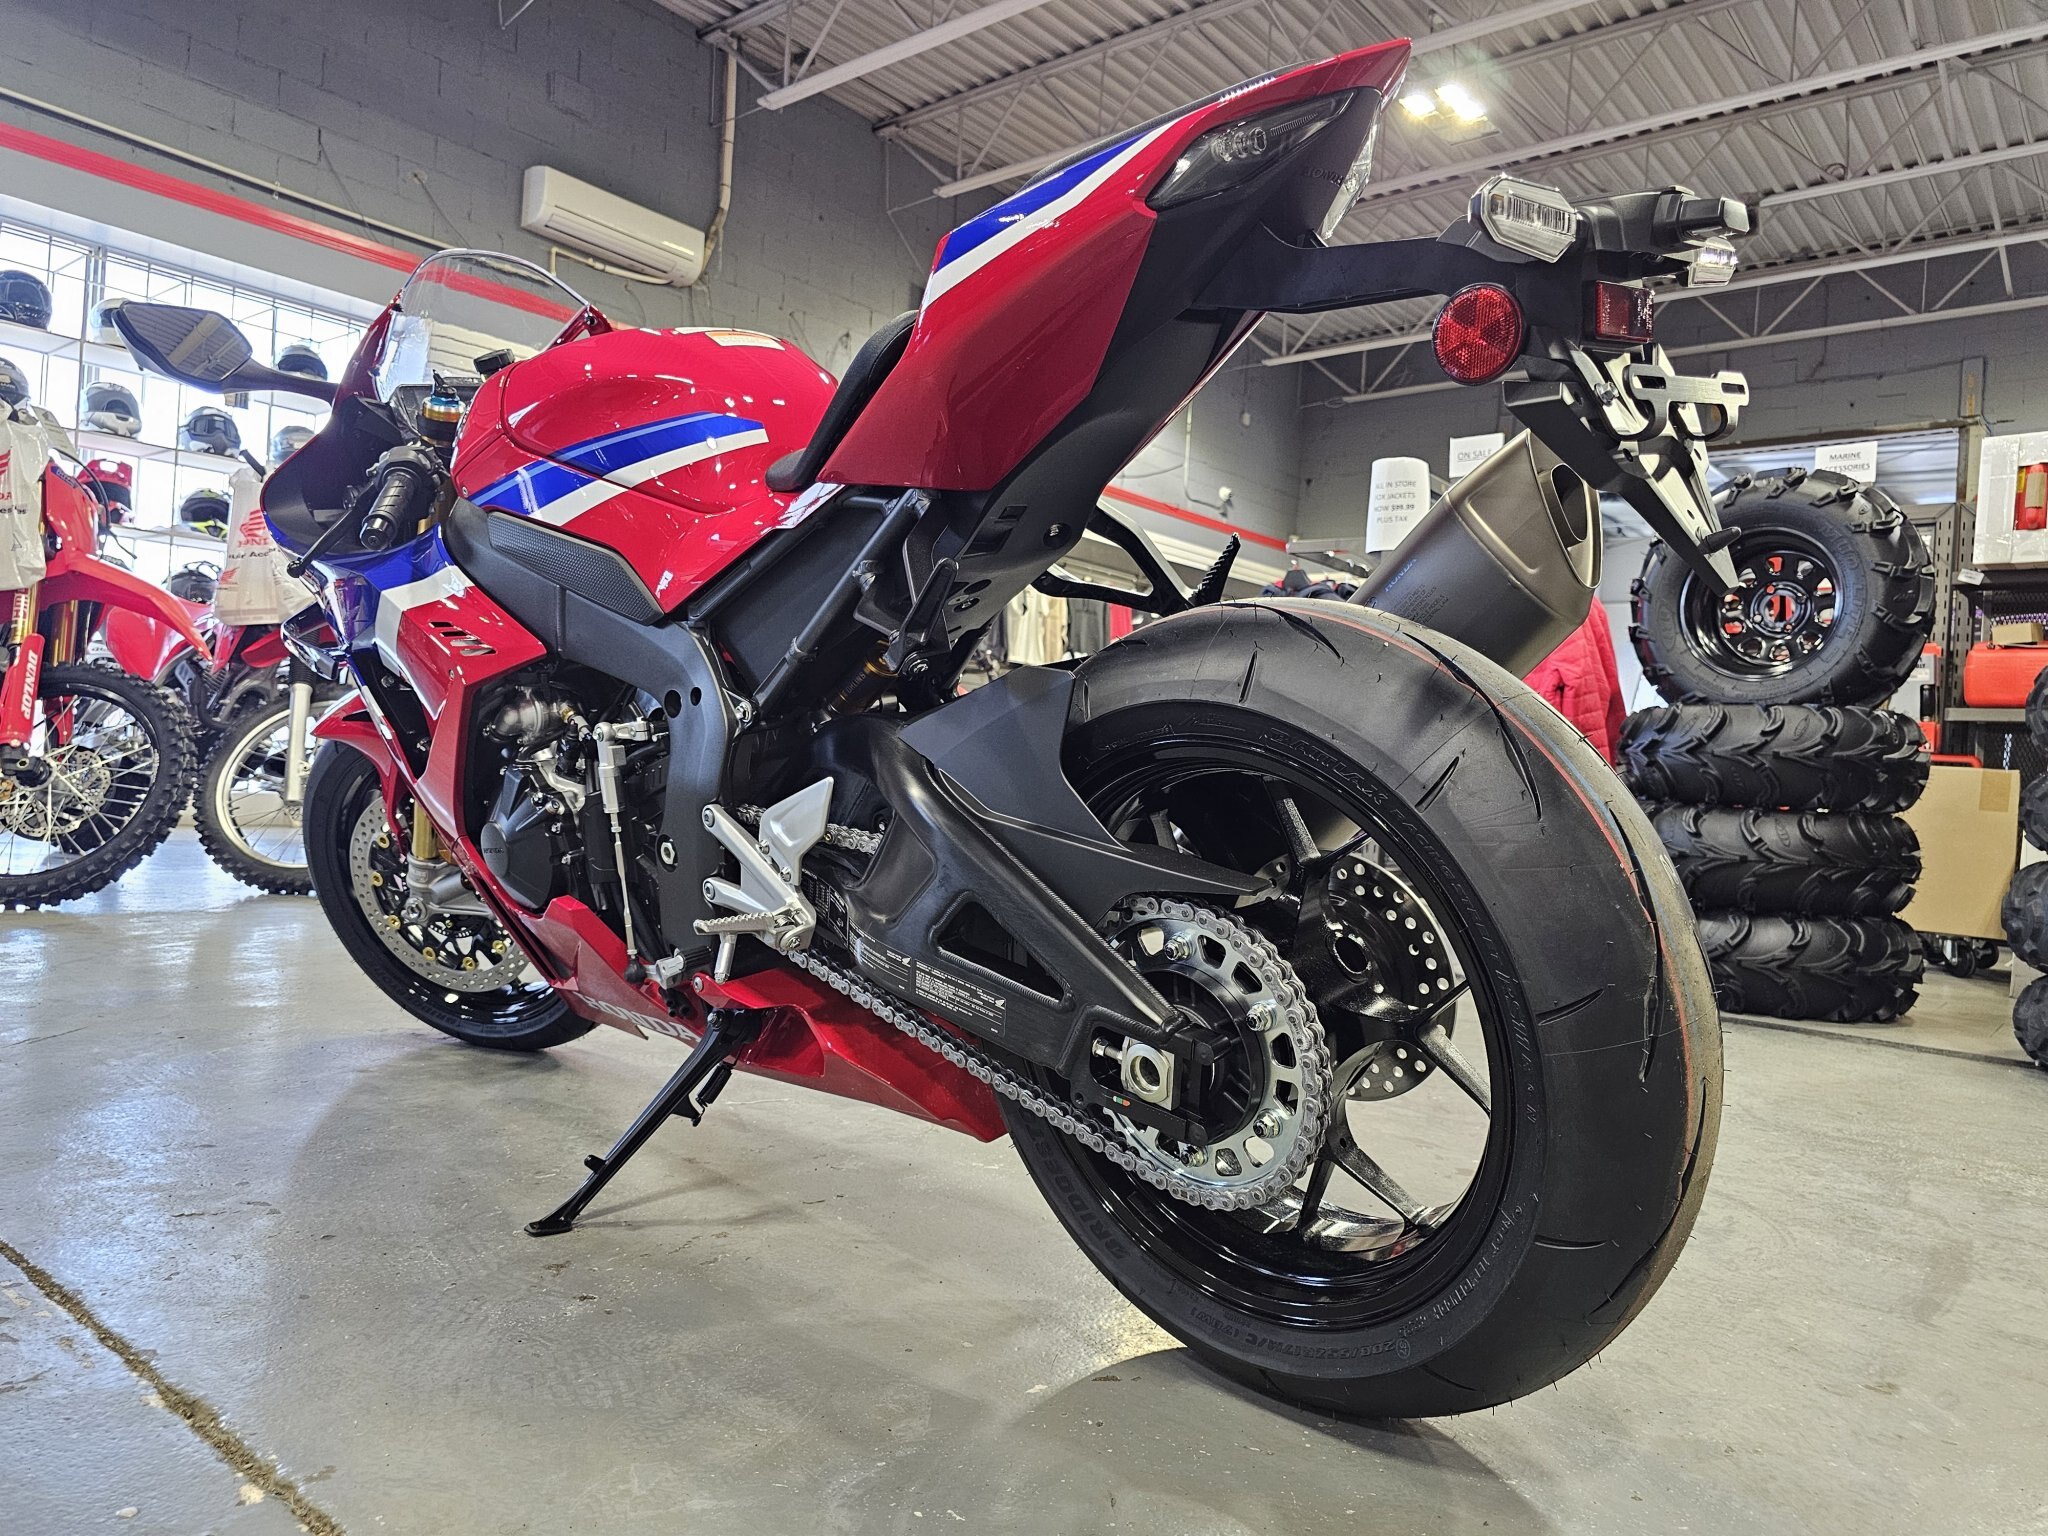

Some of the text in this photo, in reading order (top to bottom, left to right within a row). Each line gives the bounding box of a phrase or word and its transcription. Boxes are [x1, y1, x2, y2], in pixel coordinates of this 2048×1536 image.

[1457, 448, 1492, 461] ON SALE
[1829, 451, 1862, 460] MARINE
[1394, 480, 1417, 488] STORE
[1387, 492, 1416, 500] JACKETS
[1376, 515, 1408, 524] PLUS TAX
[21, 649, 38, 720] DUNLOP
[572, 991, 702, 1042] HONDA
